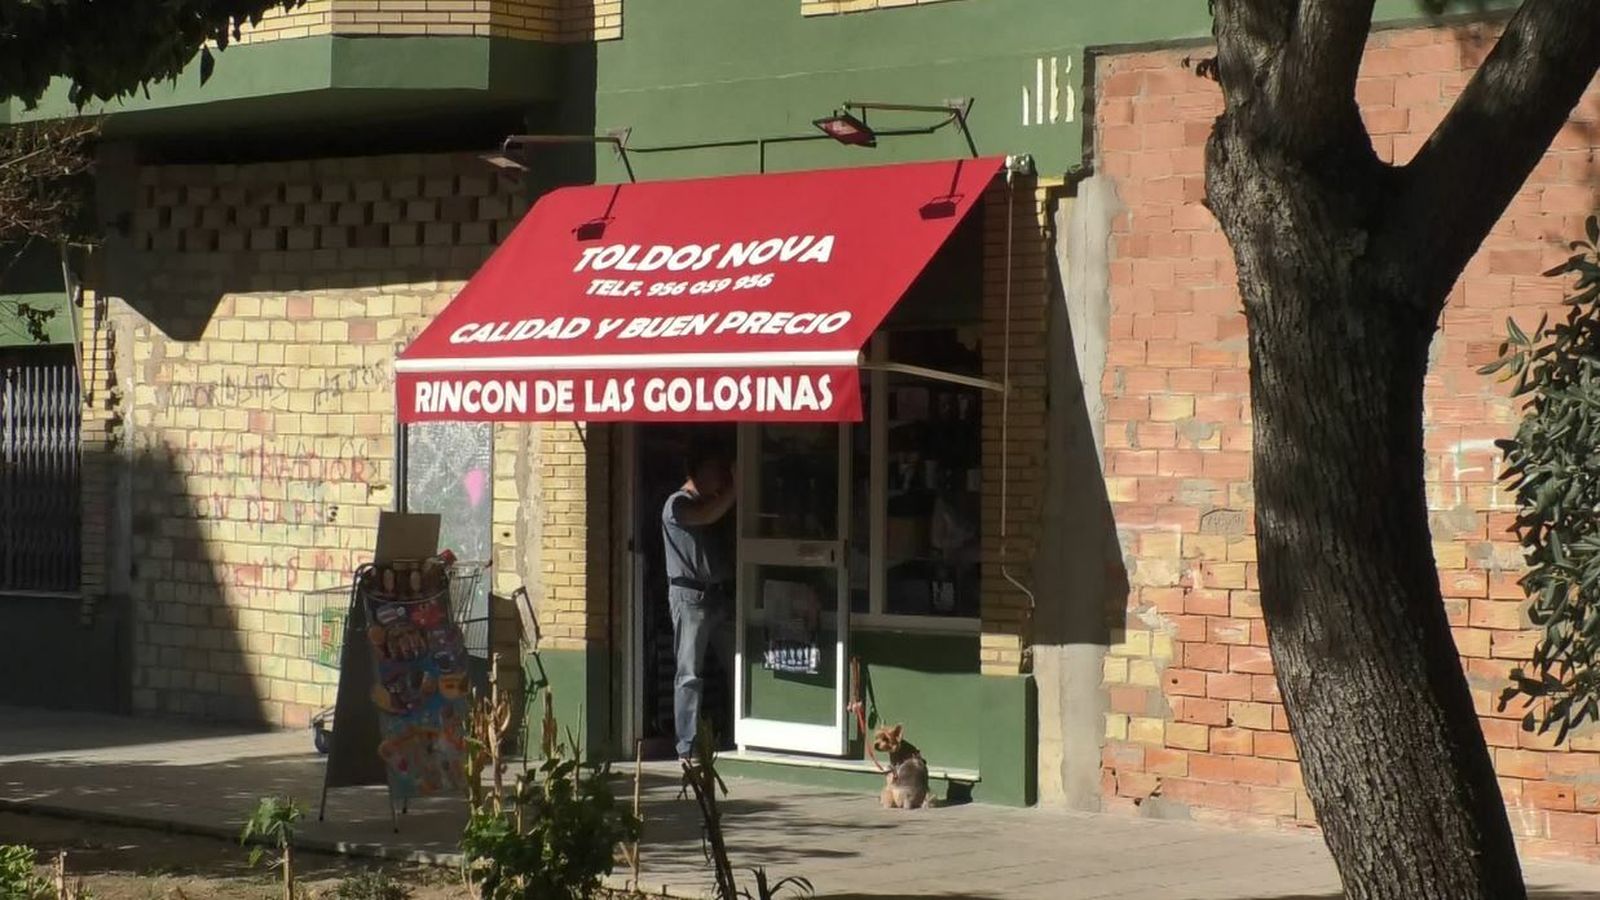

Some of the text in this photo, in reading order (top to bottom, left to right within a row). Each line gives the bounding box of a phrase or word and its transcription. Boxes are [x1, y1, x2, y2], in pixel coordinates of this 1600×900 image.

[573, 235, 836, 273] TOLDOS NOVA
[585, 272, 775, 297] TELF. 956 059 956
[449, 316, 592, 344] CALIDAD
[594, 318, 624, 340] Y
[617, 312, 720, 339] BUEN
[713, 310, 852, 335] PRECIO
[414, 374, 833, 414] RINCON DE LAS GOLOSINAS
